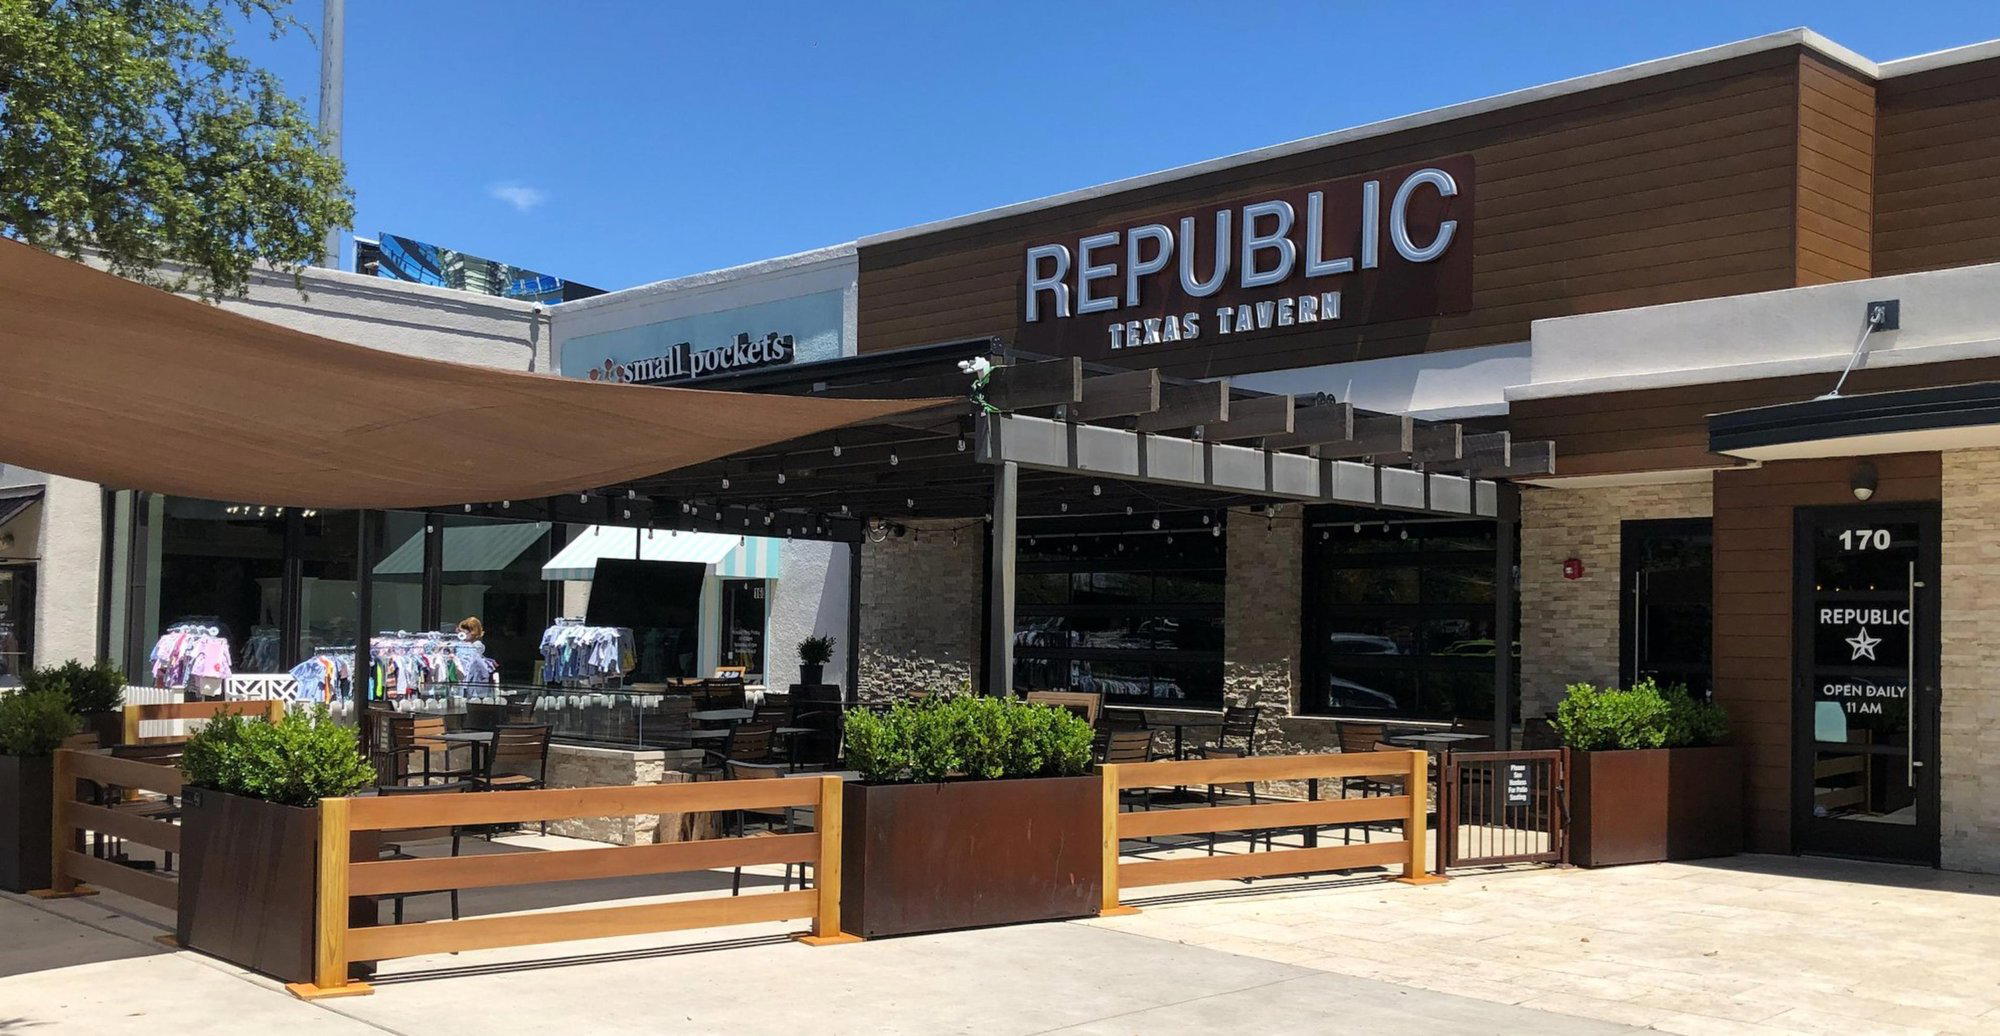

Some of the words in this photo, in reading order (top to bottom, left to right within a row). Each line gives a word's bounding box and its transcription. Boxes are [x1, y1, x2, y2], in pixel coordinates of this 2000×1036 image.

[1026, 167, 1458, 322] REPUBLIC
[1108, 312, 1201, 349] TEXAS
[1217, 291, 1342, 334] TAVERN
[623, 344, 685, 383] small
[688, 333, 786, 379] pockets
[1839, 529, 1891, 550] 170
[1820, 608, 1910, 625] REPUBLIC
[1823, 684, 1862, 697] OPEN
[1866, 685, 1907, 698] DAILY
[1846, 702, 1857, 713] 11
[1859, 702, 1882, 714] AM
